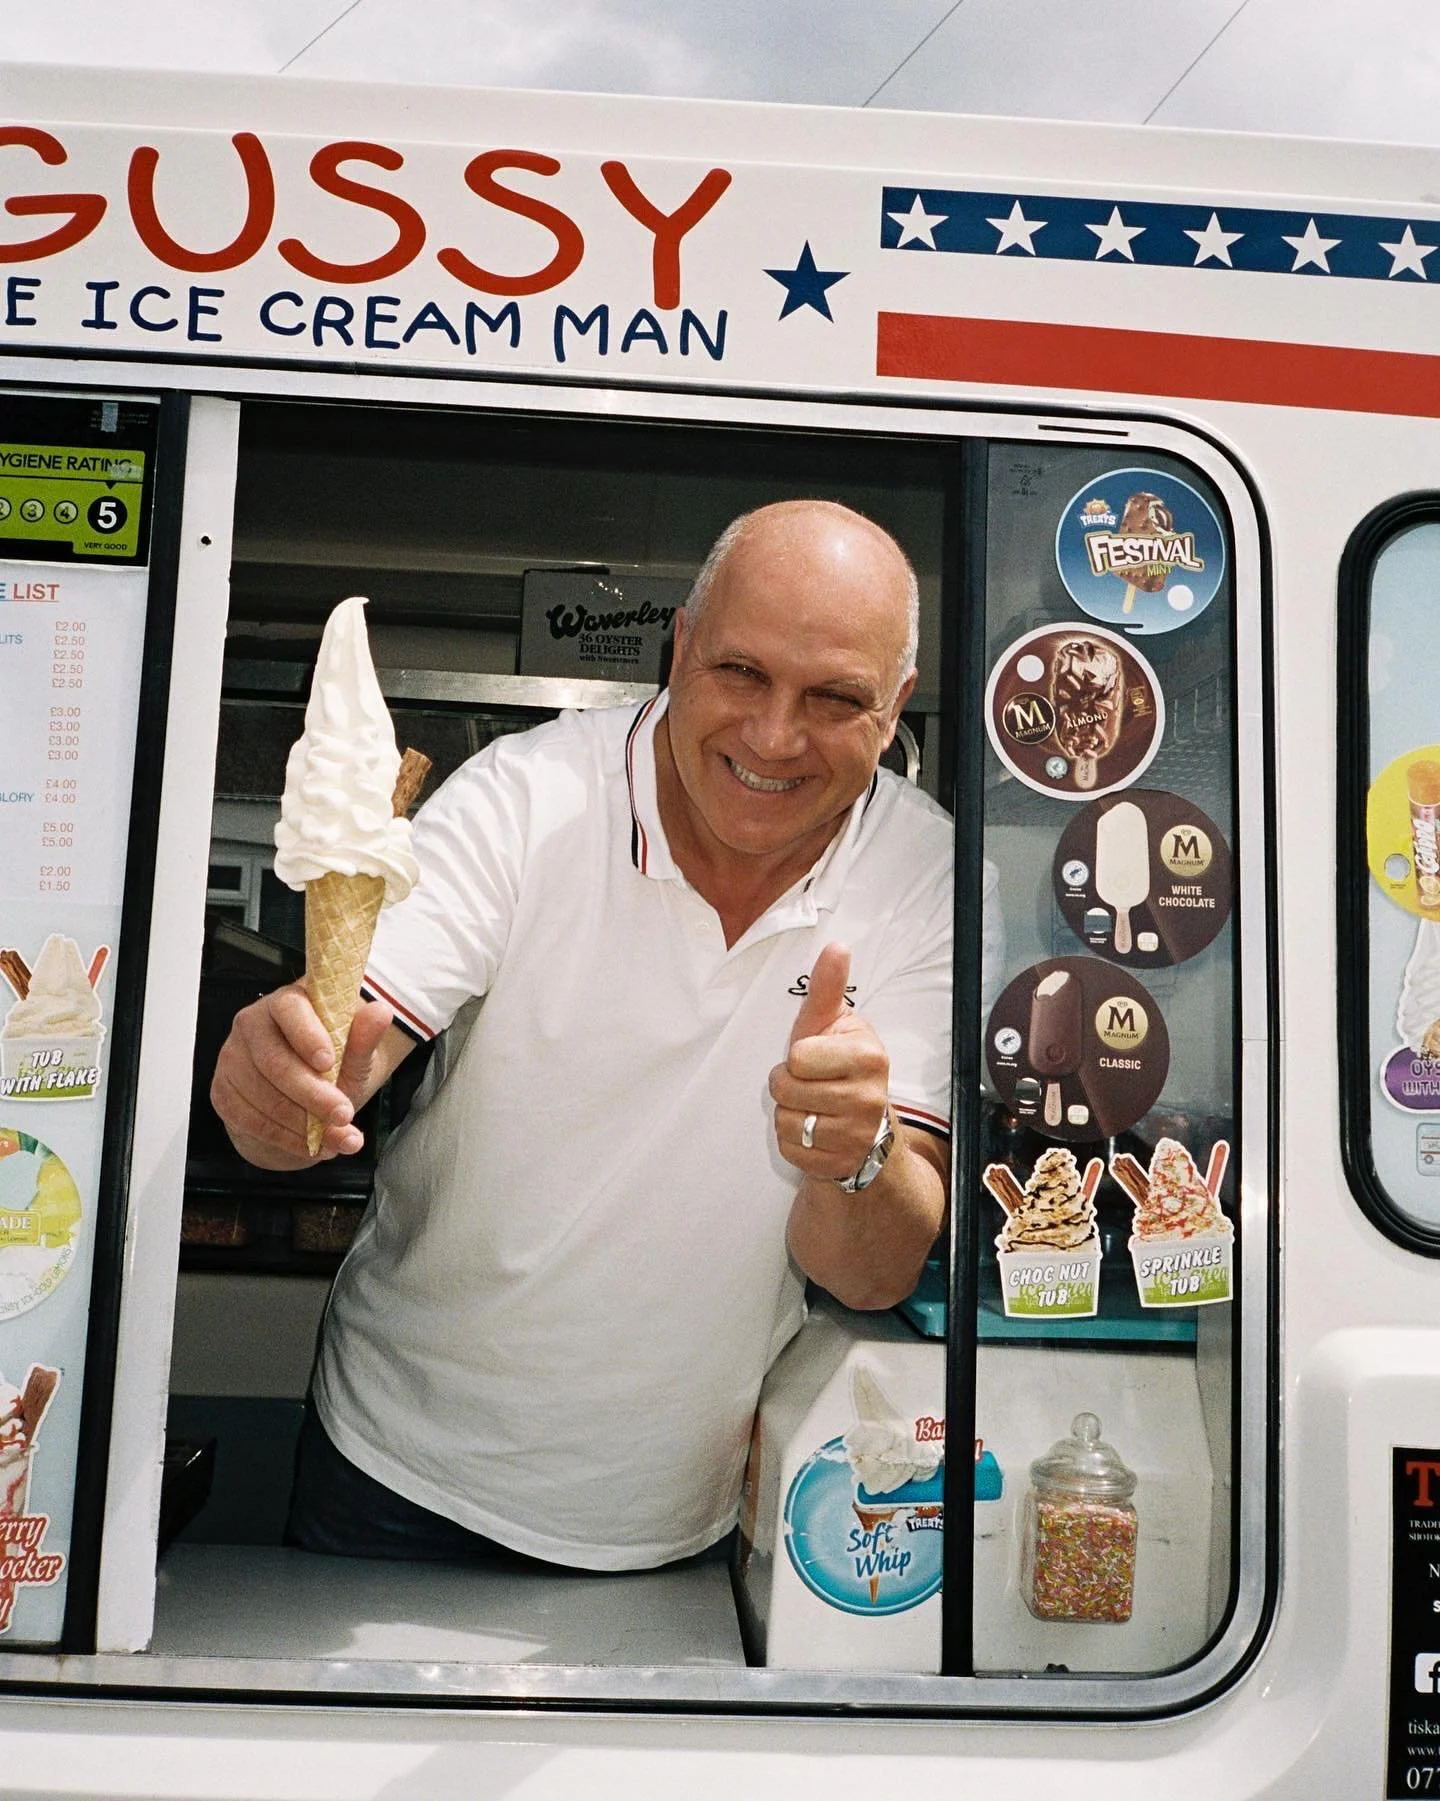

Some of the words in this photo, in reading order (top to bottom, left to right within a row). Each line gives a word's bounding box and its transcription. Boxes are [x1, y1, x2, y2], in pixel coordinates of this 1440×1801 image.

[0, 126, 732, 311] GUSSY
[81, 280, 225, 342] ICE
[259, 290, 521, 356] CREAM
[553, 303, 728, 362] MAN
[97, 501, 118, 529] 5
[1080, 513, 1117, 527] TREATS
[1087, 533, 1203, 575] FESTIVAL
[1147, 565, 1174, 577] MINT
[13, 583, 60, 600] LIST
[55, 621, 86, 632] £2.00
[546, 601, 676, 640] Waverley
[54, 635, 85, 646] £2.50
[595, 634, 643, 646] OYSTER
[53, 650, 84, 660] £2.50
[580, 644, 640, 656] DELIGHTS
[52, 664, 83, 674] £2.50
[52, 678, 82, 688] £2.50
[50, 706, 80, 717] £3.00
[49, 721, 80, 731] £3.00
[1066, 711, 1109, 730] ALMOND
[1014, 723, 1050, 739] MAGNUM
[48, 736, 79, 746] £3.00
[47, 750, 78, 760] £3.00
[46, 779, 76, 789] £4.00
[0, 791, 35, 803] LORY
[45, 794, 76, 804] £4.00
[43, 822, 73, 833] £5.00
[1169, 858, 1205, 867] MAGNUM
[40, 866, 71, 876] £2.00
[39, 881, 70, 891] £1.50
[1171, 885, 1203, 896] WHITE
[1158, 896, 1216, 909] CHOCOLATE
[1103, 1030, 1140, 1041] MAGNUM
[32, 1050, 63, 1069] TUB
[1099, 1057, 1142, 1071] CLASSIC
[0, 1075, 41, 1095] WITH
[47, 1066, 97, 1089] FLAKE
[1140, 1246, 1221, 1278] SPRINKLE
[1009, 1266, 1054, 1287] CHOC
[1059, 1261, 1091, 1281] NUT
[1170, 1275, 1200, 1297] TUB
[1038, 1288, 1068, 1308] TUB
[908, 1517, 944, 1532] TREATS
[848, 1522, 896, 1552] Soft
[855, 1548, 912, 1577] Whip
